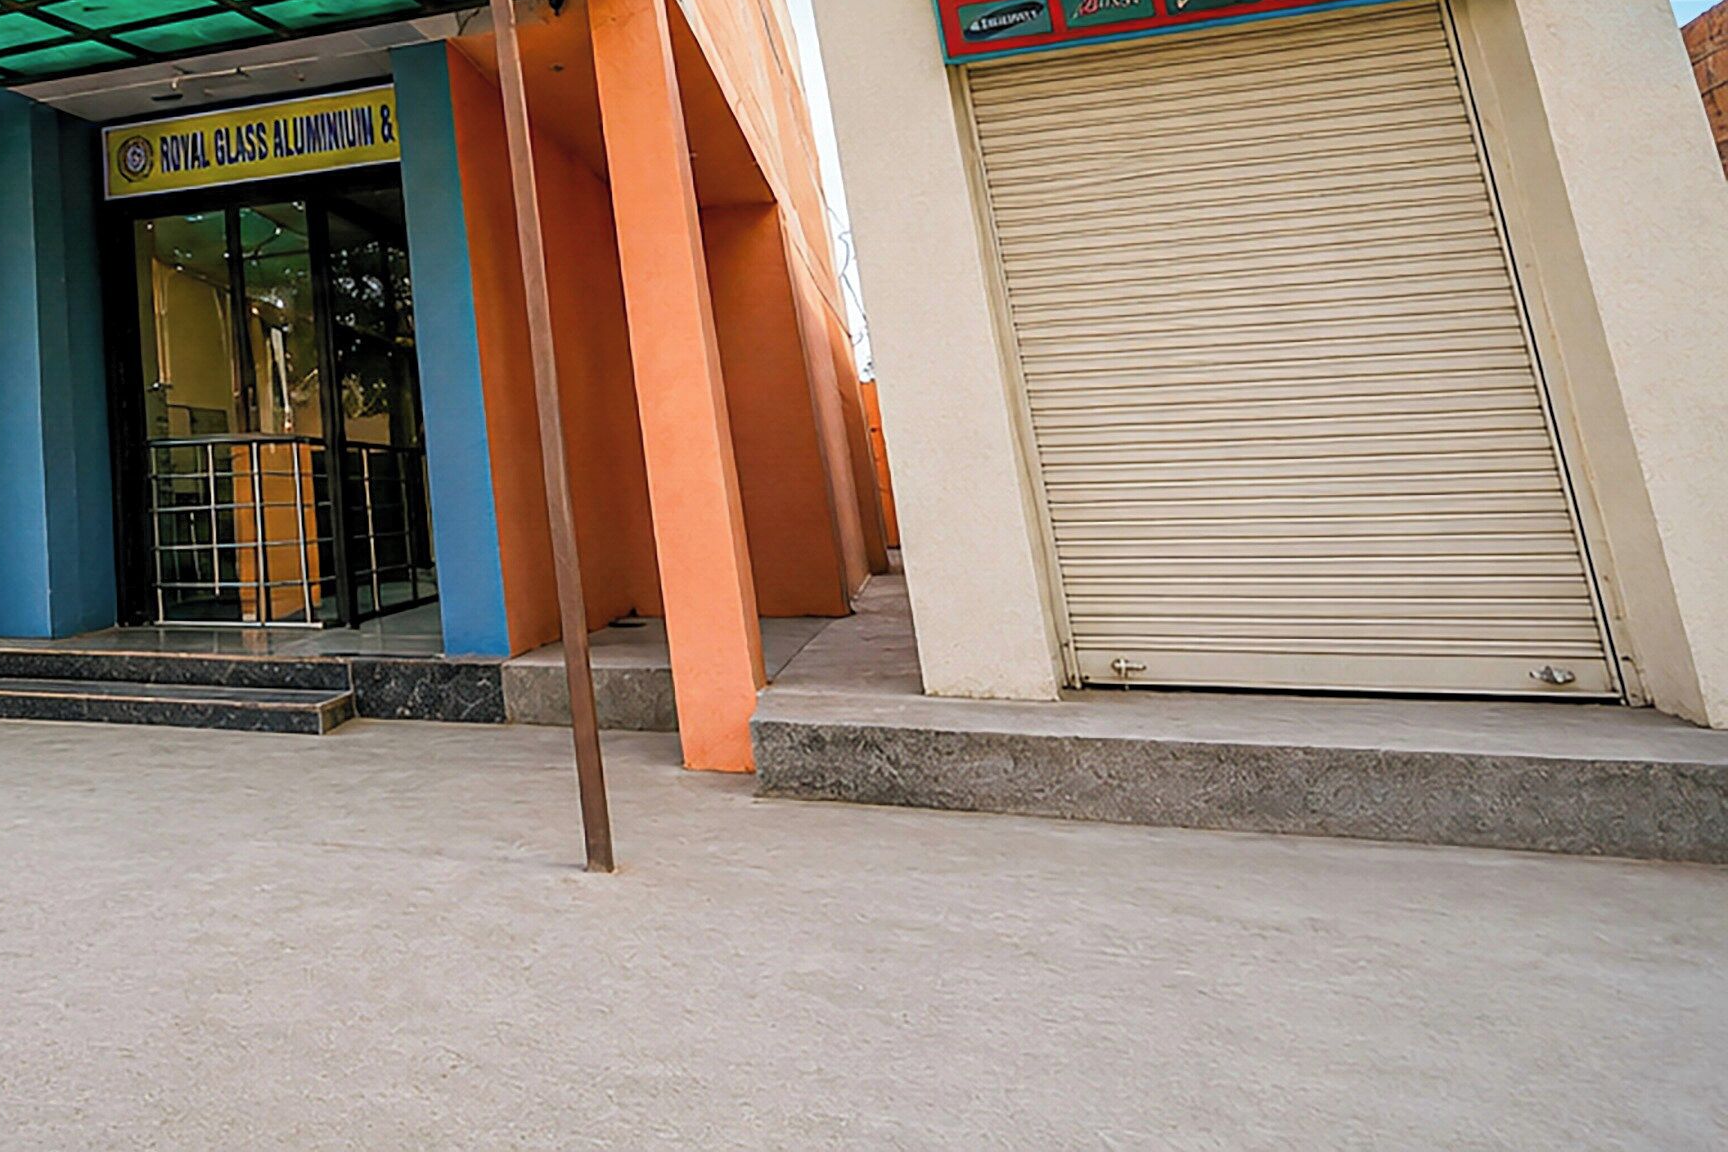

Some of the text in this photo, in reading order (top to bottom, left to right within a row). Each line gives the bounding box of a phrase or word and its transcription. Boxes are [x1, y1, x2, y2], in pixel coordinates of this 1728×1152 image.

[159, 103, 396, 174] ROYAL GLASS ALUMINIUM &
